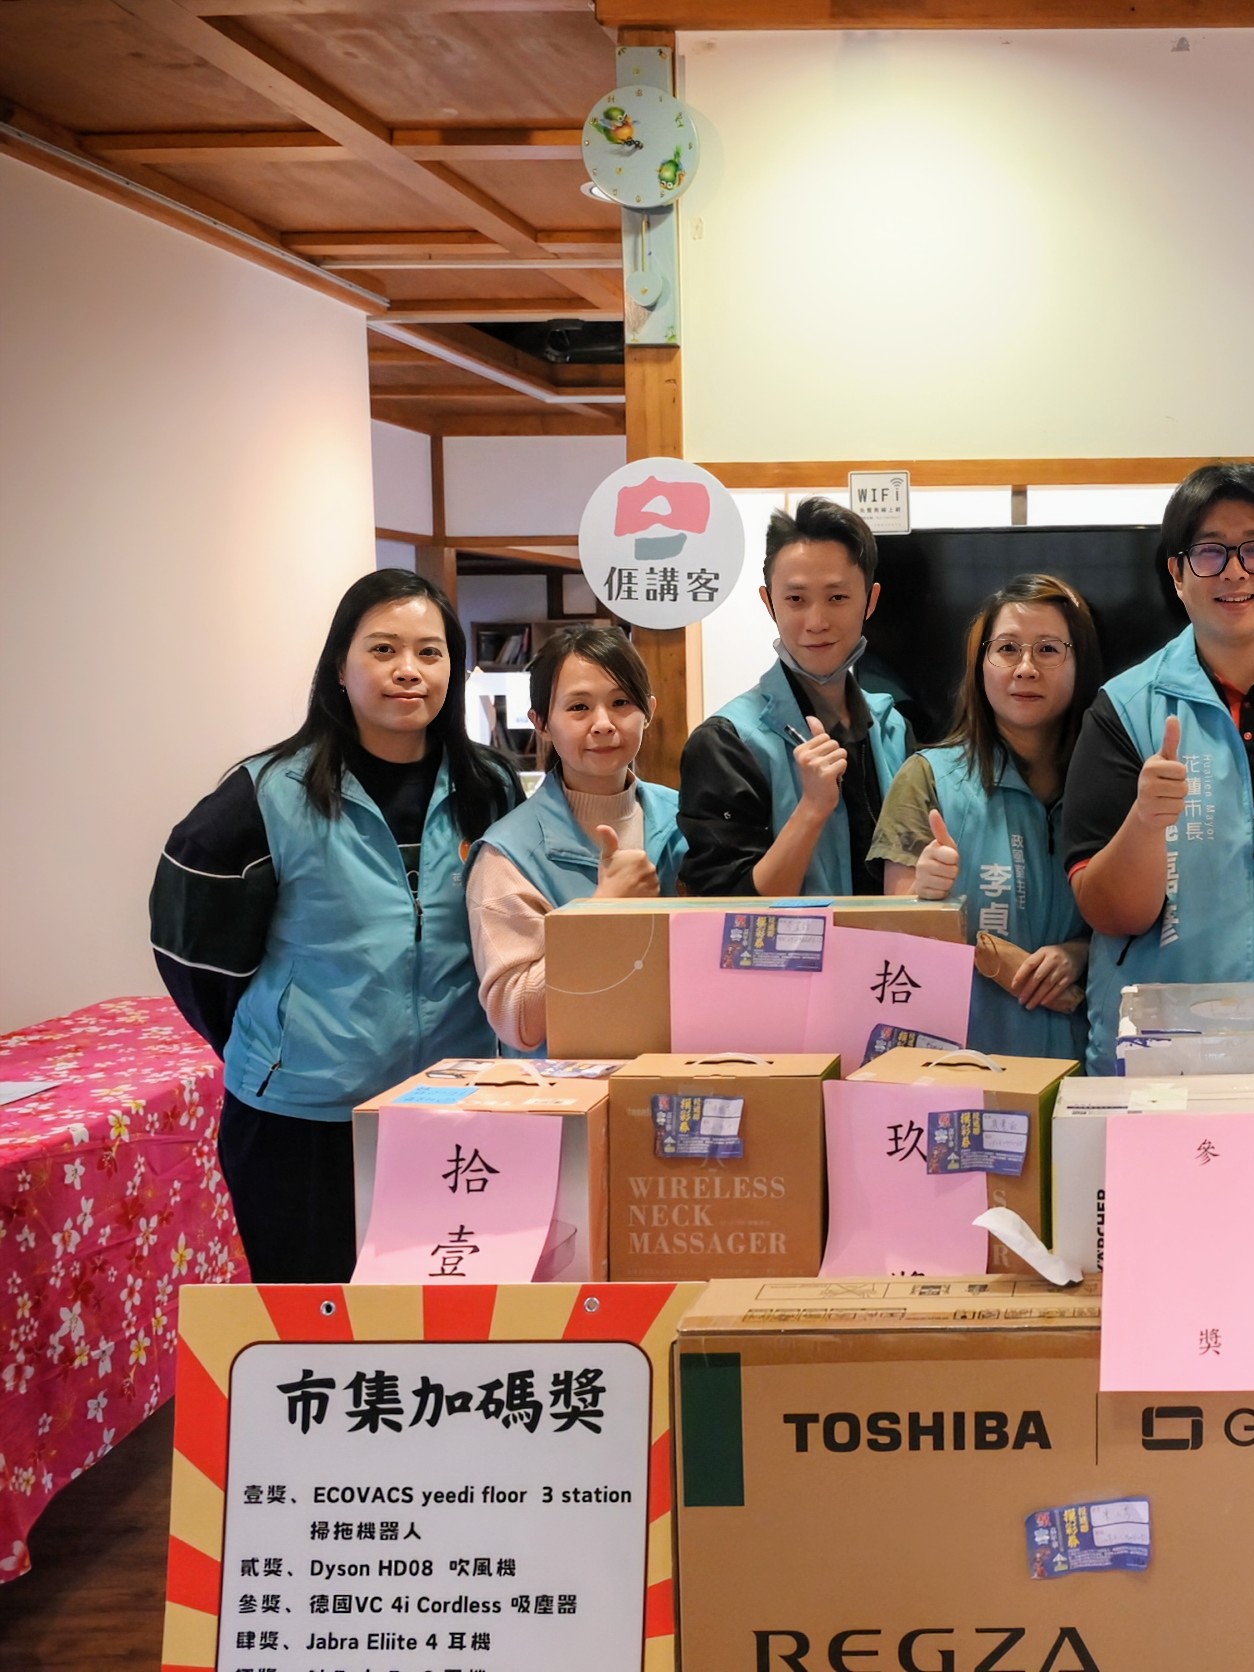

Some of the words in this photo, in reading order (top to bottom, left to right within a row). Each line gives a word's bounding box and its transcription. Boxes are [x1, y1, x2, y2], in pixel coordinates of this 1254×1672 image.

[870, 960, 922, 1005] 拾
[627, 1176, 786, 1200] WIRELESS
[627, 1204, 713, 1227] NECK
[628, 1232, 788, 1255] MASSAGER
[1198, 1328, 1222, 1355] 獎
[276, 1367, 608, 1435] 市集加碼獎
[783, 1410, 1052, 1453] TOSHIBA
[313, 1486, 414, 1505] ECOVACS
[421, 1485, 475, 1509] yeedi
[481, 1484, 527, 1504] floor
[541, 1486, 554, 1504] 3
[561, 1485, 632, 1504] station
[310, 1520, 422, 1543] 掃拖機器人
[310, 1558, 371, 1582] Dyson
[378, 1559, 434, 1578] HD08
[448, 1558, 517, 1579] 吹風機
[391, 1594, 410, 1614] 4i
[416, 1594, 502, 1615] Cordless
[511, 1595, 578, 1616] 吸塵器
[306, 1631, 360, 1651] Jabra
[366, 1631, 419, 1651] Eliite
[425, 1632, 438, 1650] 4
[448, 1631, 491, 1651] 耳機
[751, 1626, 1101, 1672] REGZA
